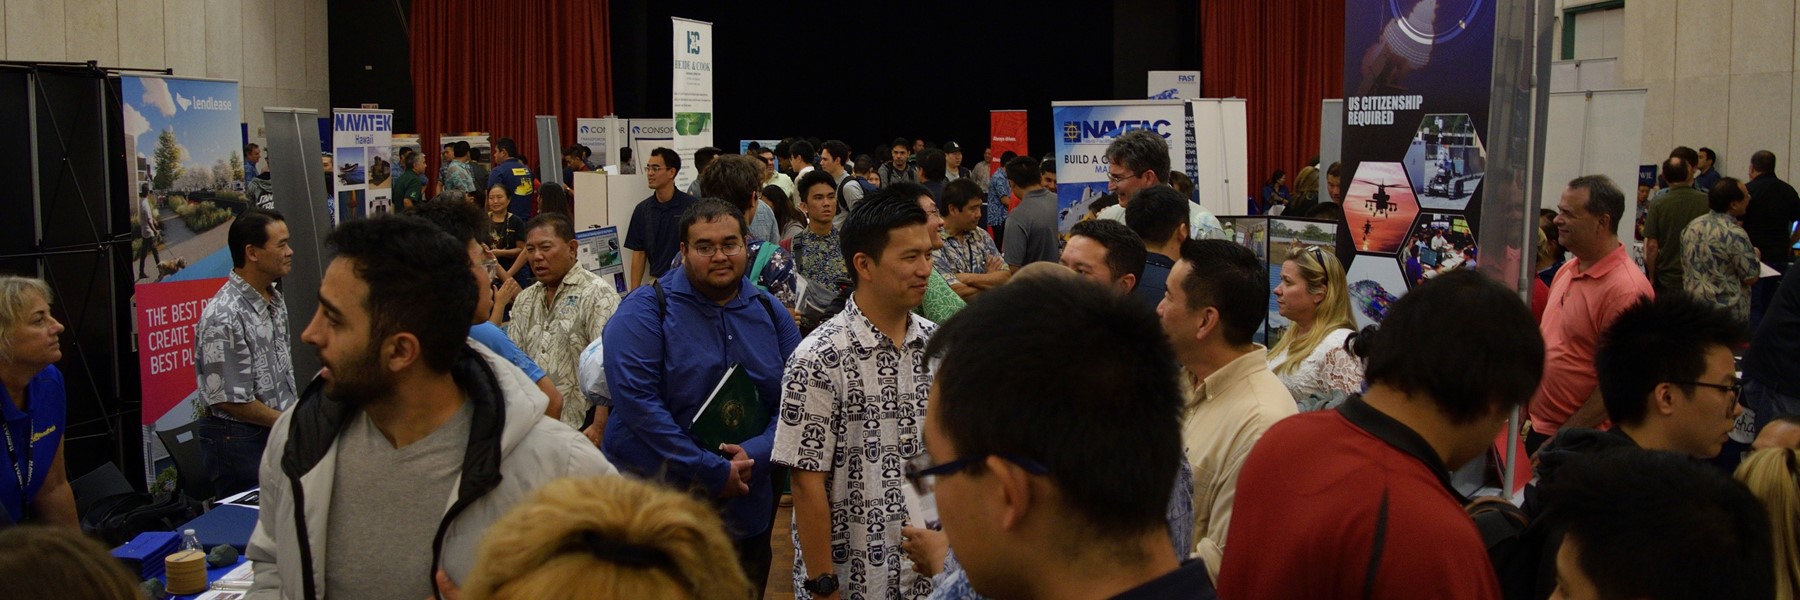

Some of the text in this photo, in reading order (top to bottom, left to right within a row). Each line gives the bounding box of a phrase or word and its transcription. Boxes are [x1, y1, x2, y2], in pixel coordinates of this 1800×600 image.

[192, 96, 232, 110] lendlease
[1348, 95, 1423, 111] US CITIZENSHIP
[336, 113, 392, 132] NAVATEK
[1348, 111, 1394, 126] REQUIRED
[1082, 120, 1172, 138] NAVFAC
[356, 134, 374, 144] Hawaii
[1064, 155, 1090, 164] BUILD
[1092, 156, 1098, 164] A
[146, 306, 168, 328] THE
[172, 301, 198, 322] BEST
[148, 326, 190, 351] CREATE
[150, 348, 195, 374] BEST PL
